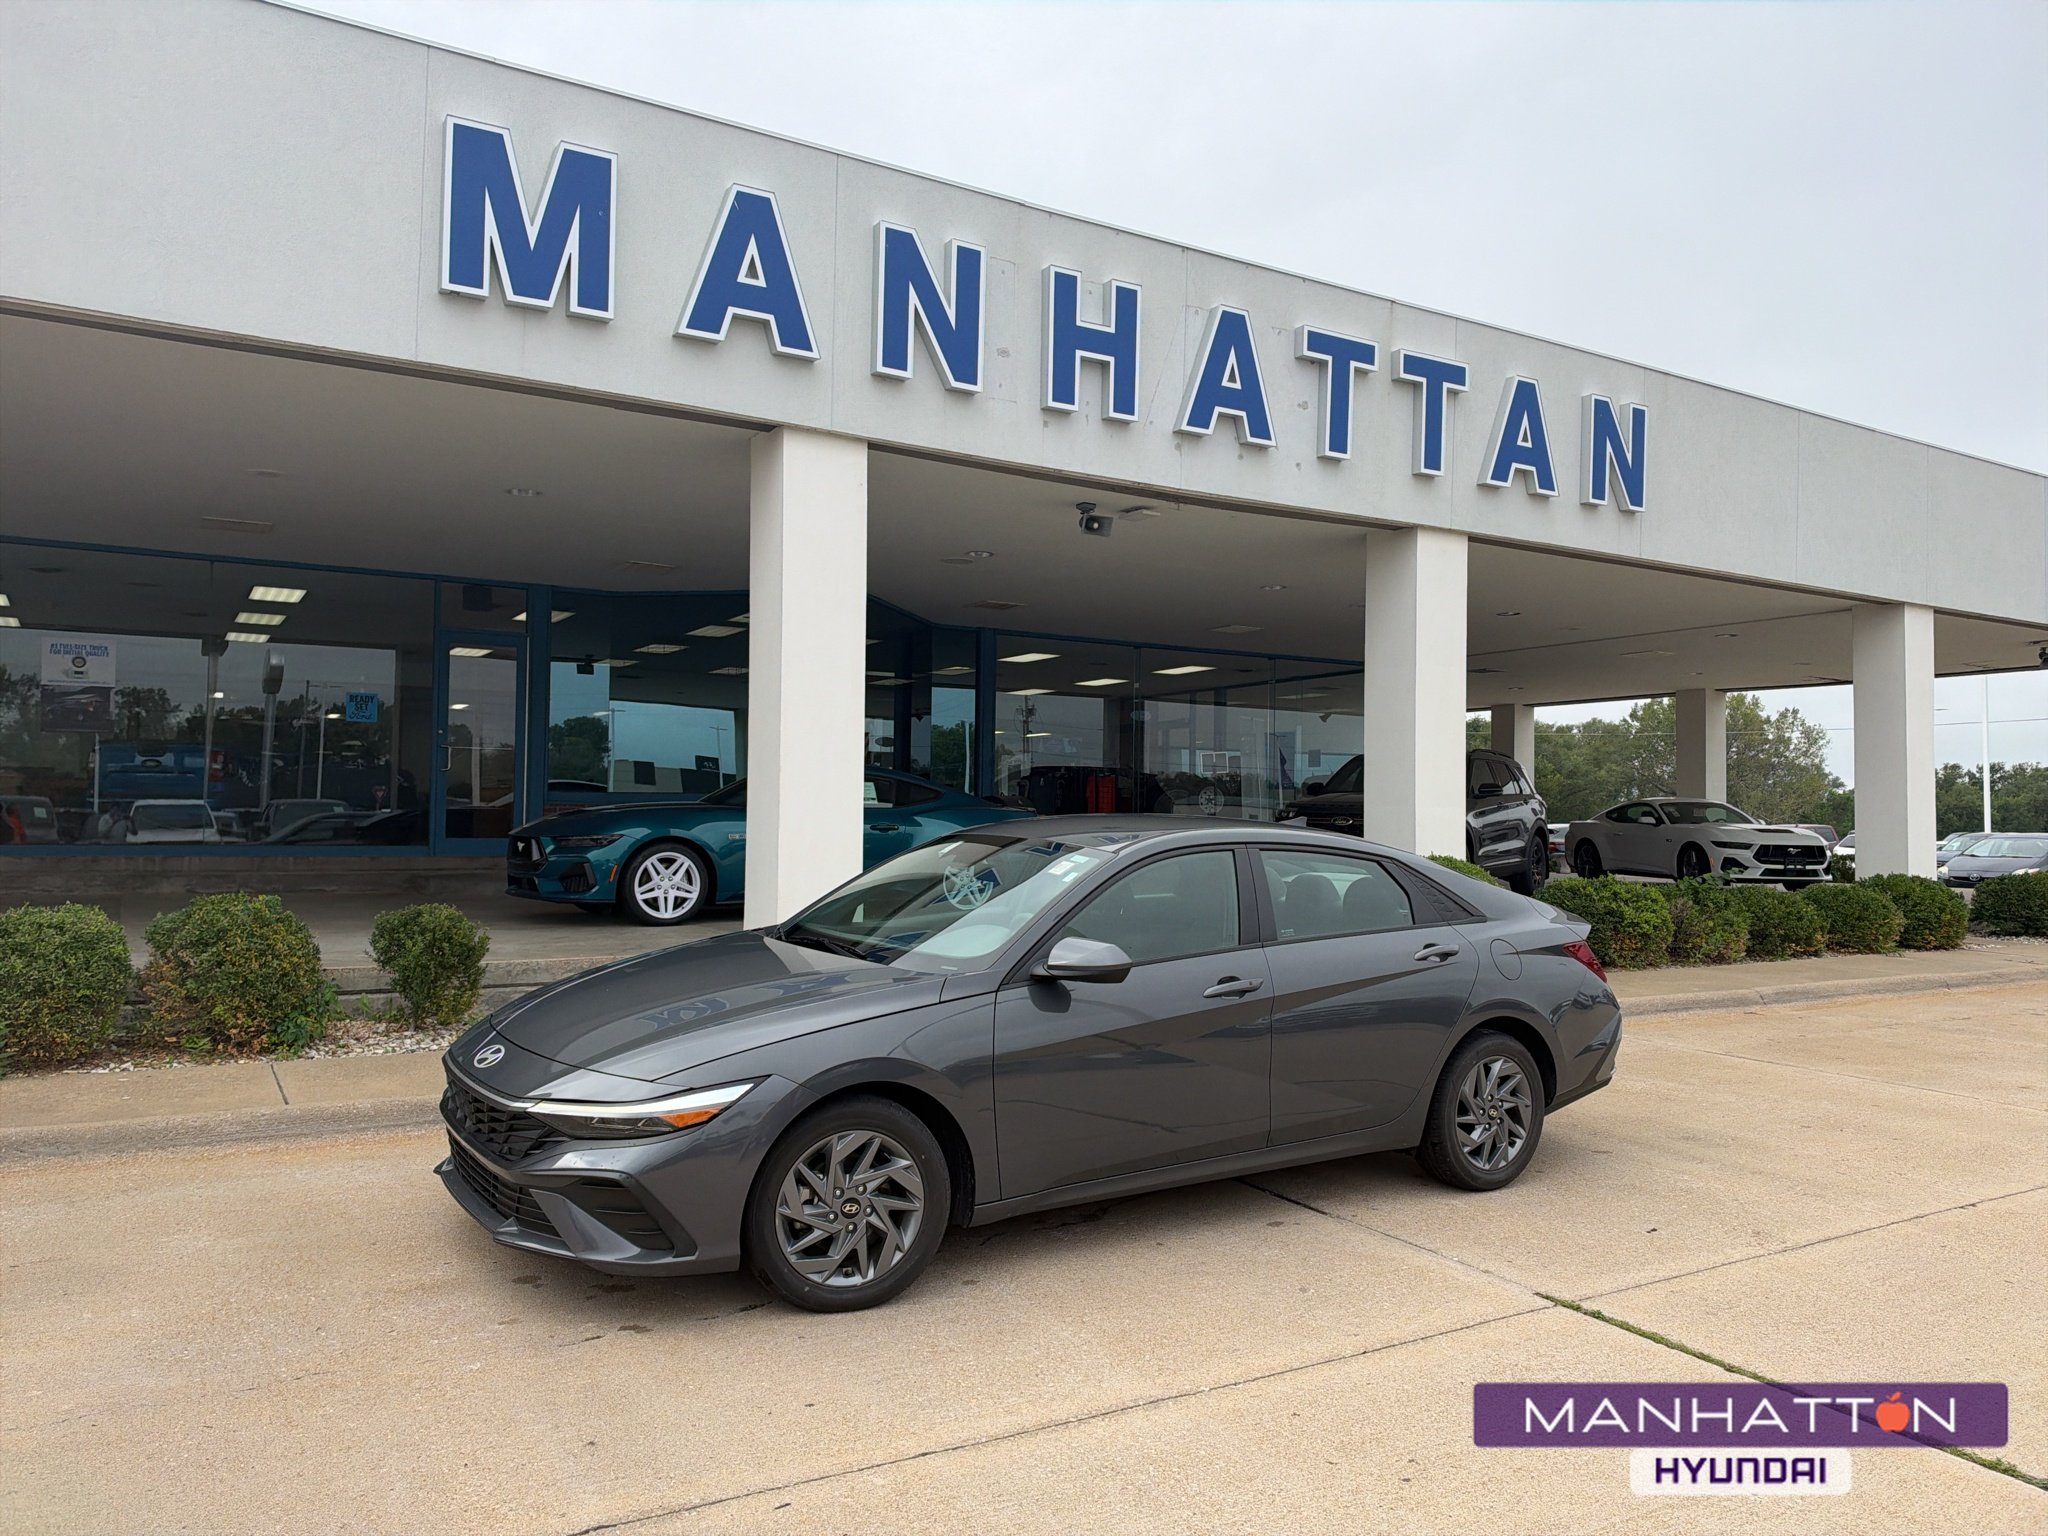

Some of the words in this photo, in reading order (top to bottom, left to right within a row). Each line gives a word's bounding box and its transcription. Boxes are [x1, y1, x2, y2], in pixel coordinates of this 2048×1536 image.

[440, 114, 1648, 513] MANHATTAN
[349, 694, 375, 704] READY
[354, 703, 369, 711] SET
[349, 711, 374, 720] Ford
